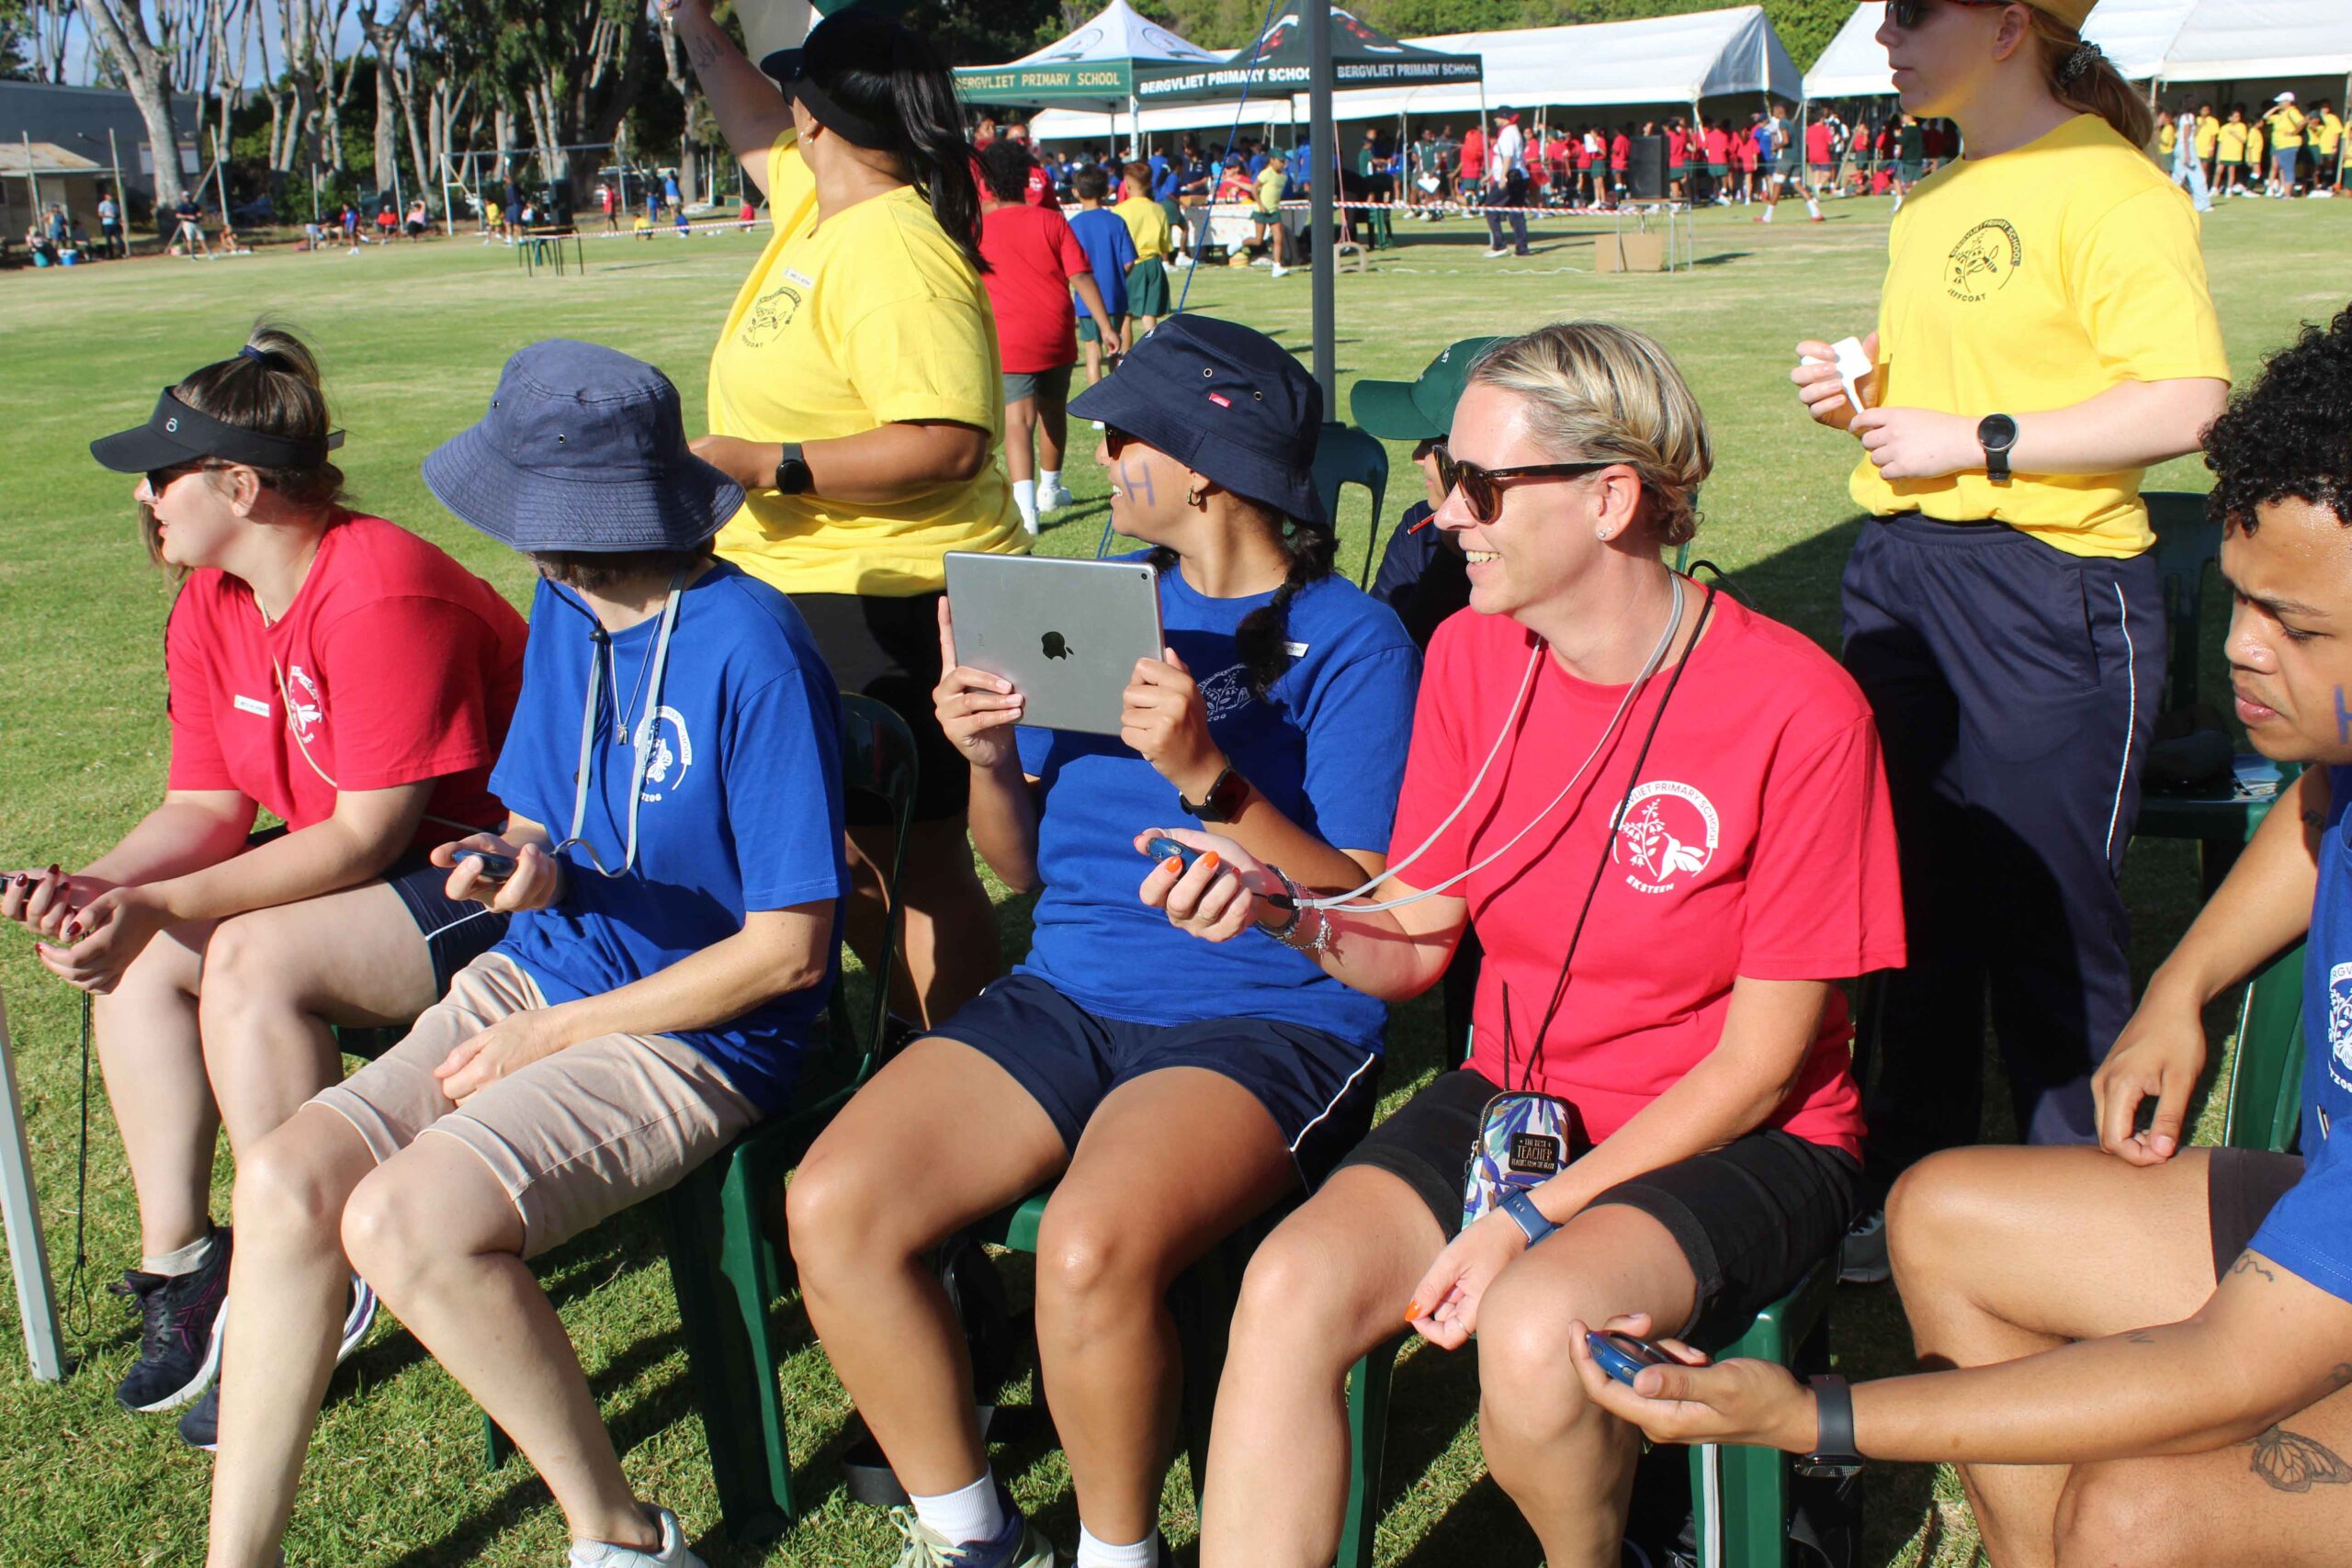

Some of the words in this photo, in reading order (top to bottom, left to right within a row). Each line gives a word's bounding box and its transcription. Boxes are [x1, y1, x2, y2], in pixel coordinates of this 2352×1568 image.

[1337, 64, 1395, 79] BERGVLIET
[1396, 63, 1441, 77] PRIMARY
[1442, 62, 1479, 76] SCHOOL
[1022, 72, 1070, 87] PRIMARY
[1077, 72, 1121, 86] SCHOOL
[1139, 74, 1204, 94] BERGVLIET
[1207, 68, 1265, 86] PRIMARY
[1120, 459, 1156, 507] H
[1655, 783, 1700, 799] PRIMARY
[1625, 874, 1674, 894] EKSTEEN
[1517, 1145, 1553, 1161] TEACHER
